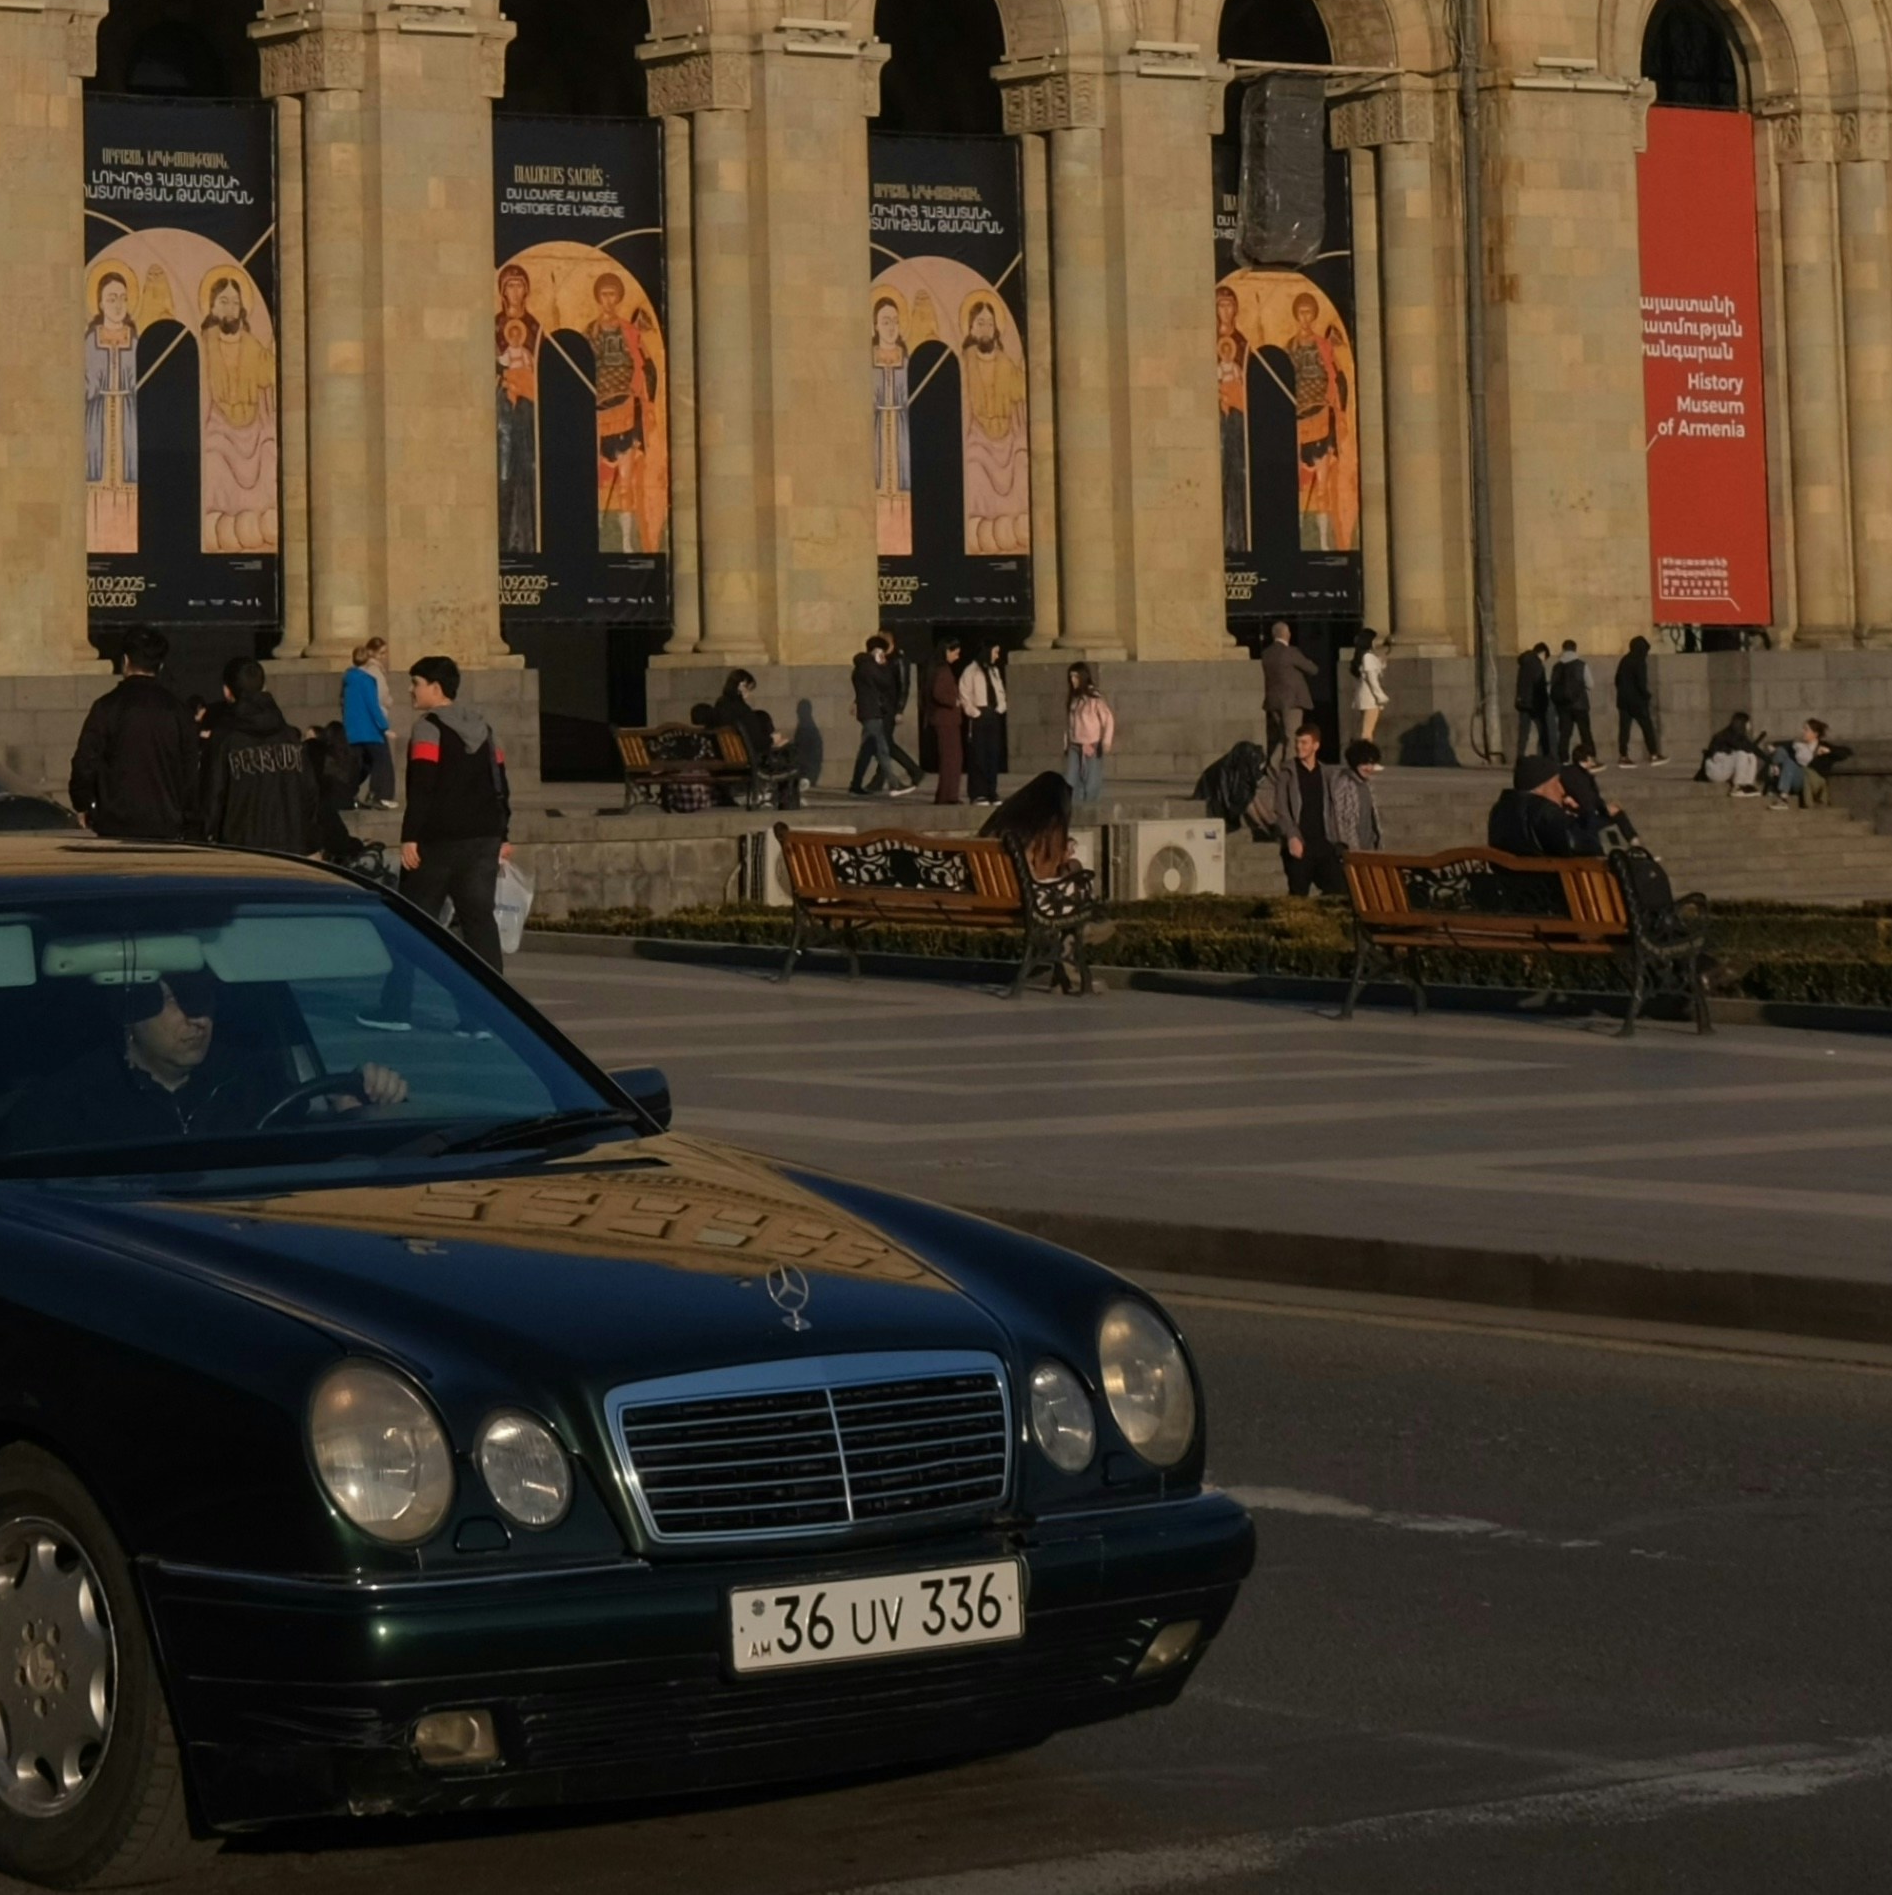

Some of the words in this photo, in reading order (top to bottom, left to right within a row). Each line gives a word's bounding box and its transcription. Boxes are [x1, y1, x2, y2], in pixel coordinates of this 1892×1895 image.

[514, 164, 565, 185] DIALOGUES
[506, 187, 522, 200] DU
[523, 189, 564, 202] LOUVRE
[566, 190, 580, 202] AU
[582, 189, 619, 204] MUSÉE
[500, 202, 556, 216] D'HISTOIRE
[557, 204, 571, 216] DE
[1639, 295, 1735, 319] այաստանի
[1643, 316, 1743, 341] ատմության
[1687, 371, 1743, 396] History
[1676, 395, 1744, 415] Museum
[1657, 418, 1674, 436] of
[1678, 419, 1745, 438] Armenia
[774, 1591, 834, 1654] 36
[851, 1595, 904, 1645] UV
[920, 1571, 1002, 1637] 336
[748, 1640, 772, 1658] AM
